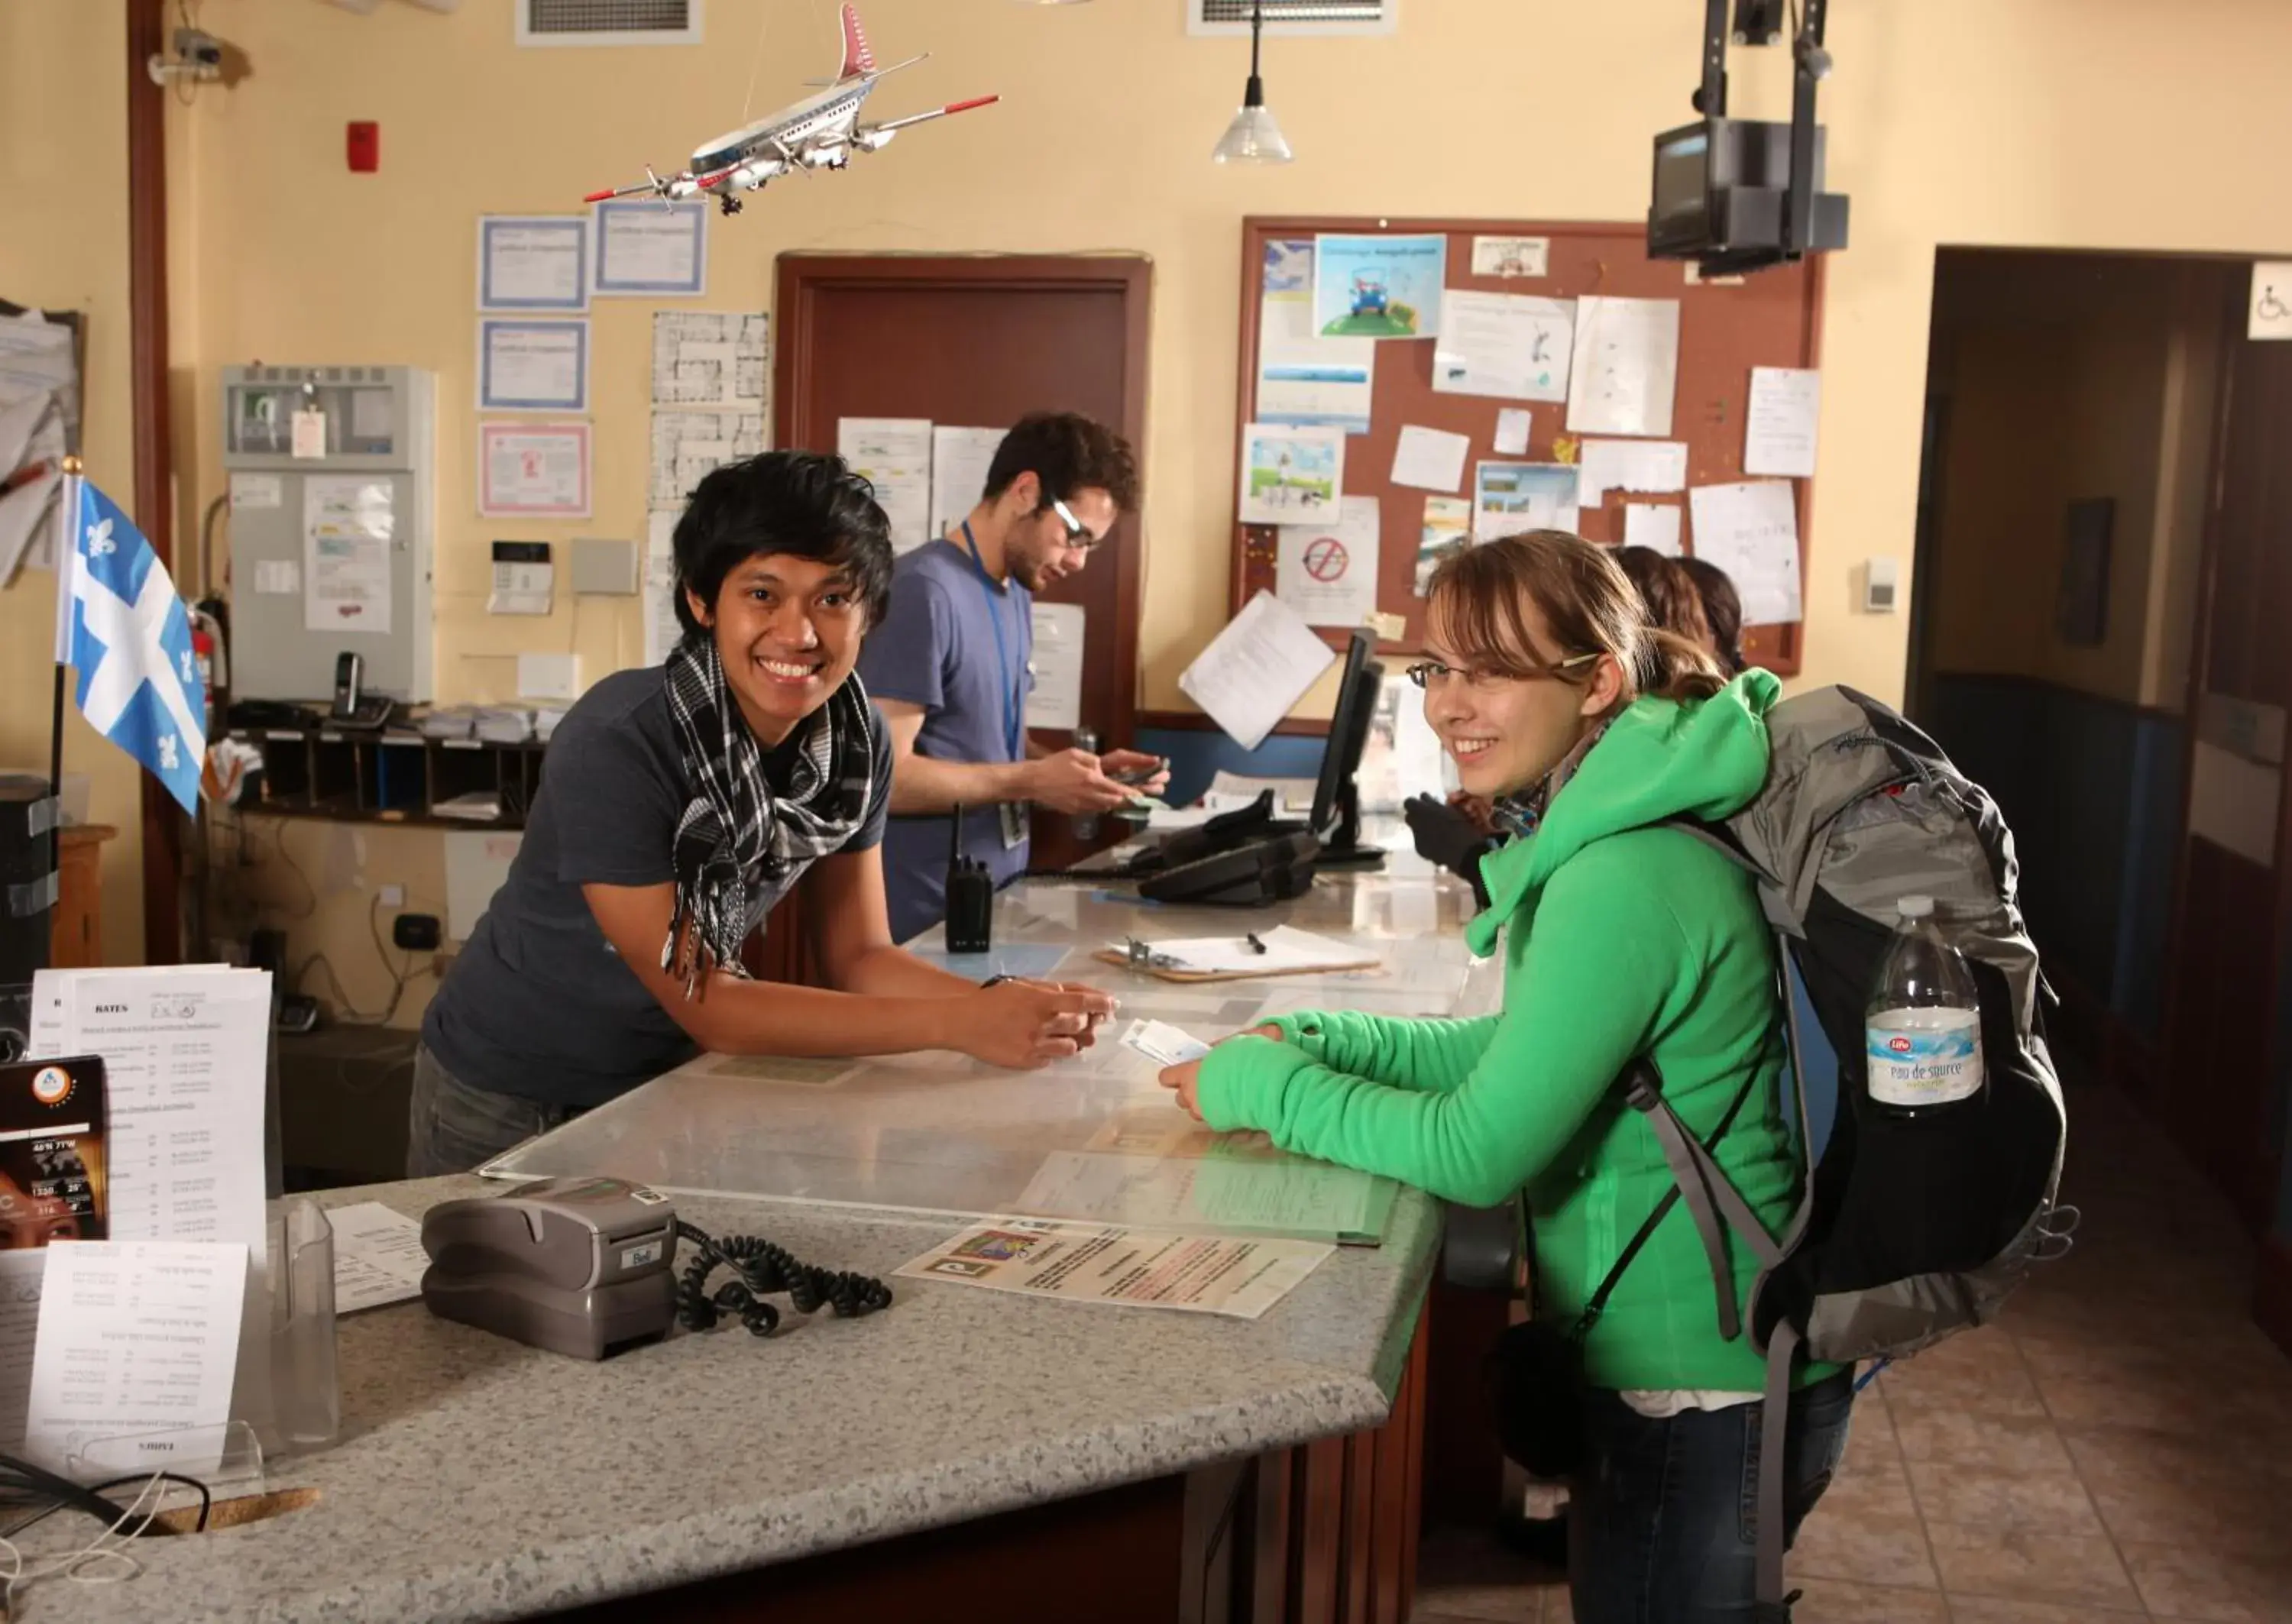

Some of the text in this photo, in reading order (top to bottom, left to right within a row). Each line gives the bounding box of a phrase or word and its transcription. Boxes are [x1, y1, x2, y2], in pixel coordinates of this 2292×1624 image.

[96, 1004, 128, 1014] RATES
[1891, 1040, 1908, 1049] Life
[1890, 1063, 1962, 1079] eau de source
